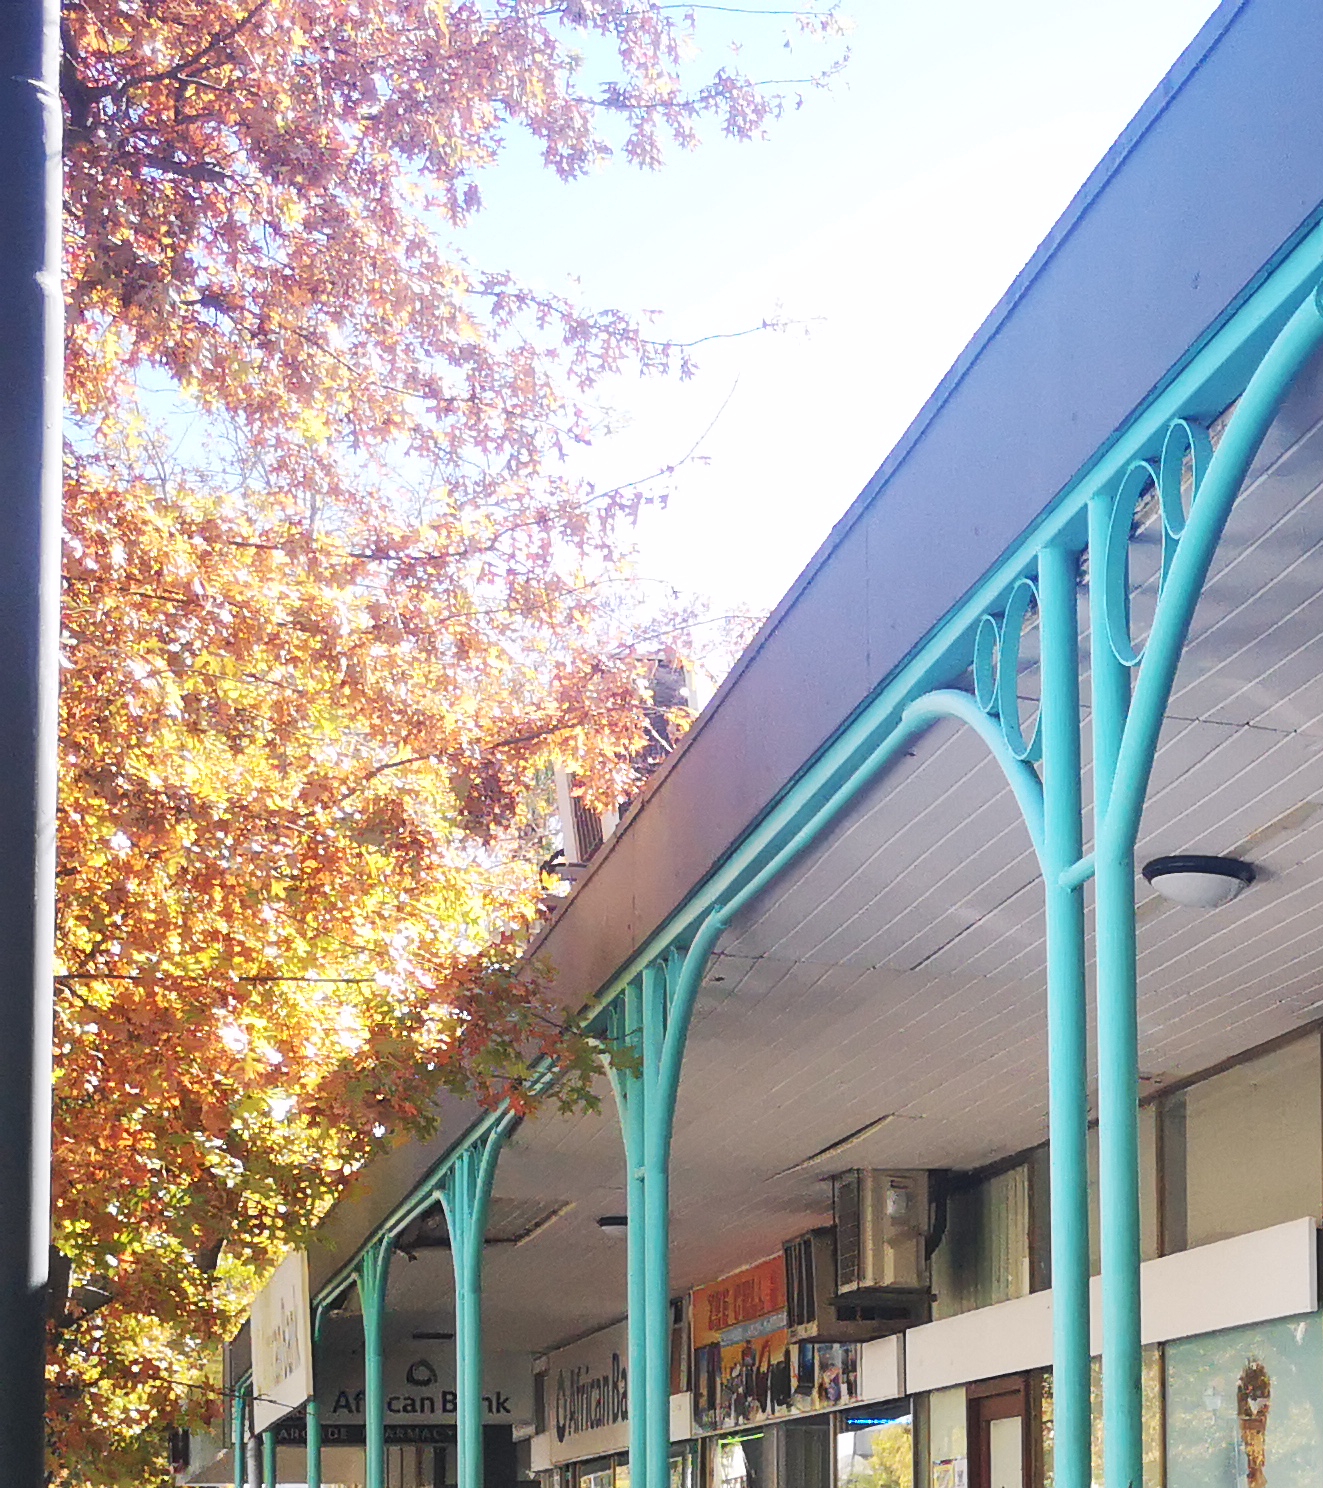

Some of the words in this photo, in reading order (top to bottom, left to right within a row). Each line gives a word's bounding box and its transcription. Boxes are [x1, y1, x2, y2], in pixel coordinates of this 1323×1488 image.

[333, 1390, 435, 1414] Afcan
[441, 1390, 511, 1414] Bnk
[611, 1352, 629, 1424] Ba
